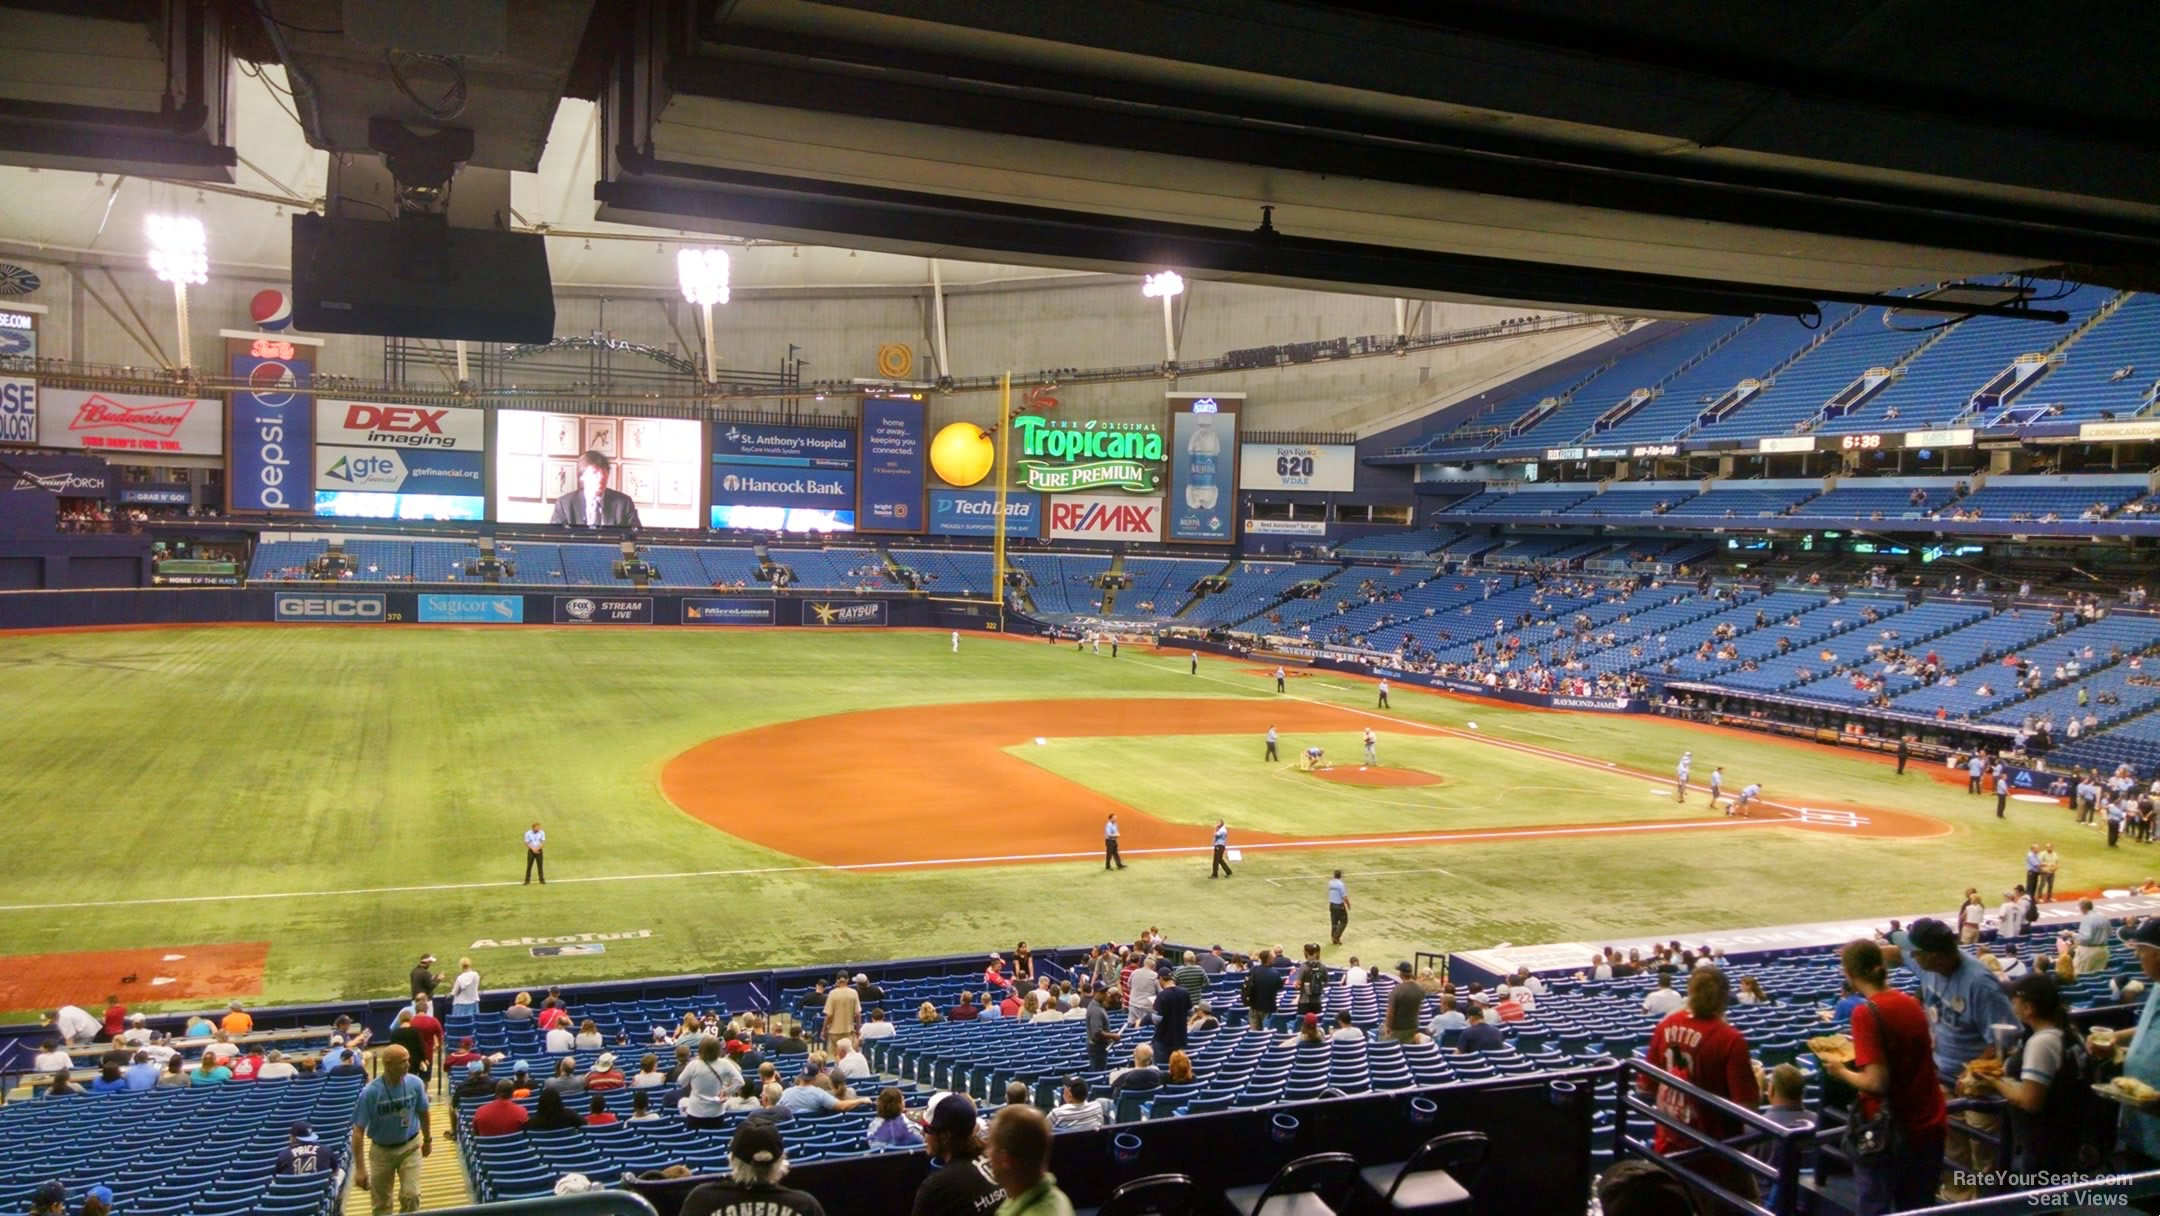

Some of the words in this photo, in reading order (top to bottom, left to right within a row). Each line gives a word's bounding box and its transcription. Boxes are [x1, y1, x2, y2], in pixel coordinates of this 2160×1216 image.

[0, 383, 34, 415] SE
[80, 402, 184, 425] Budweiser
[343, 405, 449, 434] DEX
[882, 418, 905, 427] home
[1051, 420, 1078, 429] THE
[1101, 422, 1157, 431] ORIGINAL
[138, 440, 158, 449] FOR
[367, 431, 457, 448] imaging
[741, 434, 755, 444] St.
[756, 435, 805, 449] Anthony's
[806, 439, 847, 450] Hospital
[870, 436, 901, 446] keeping
[902, 439, 916, 447] you
[1014, 415, 1163, 462] Tropicana
[1842, 434, 1881, 449] 6:38
[872, 447, 914, 456] connected.
[255, 416, 290, 508] pepsi
[353, 455, 393, 478] gte
[1276, 456, 1314, 477] 620
[360, 475, 399, 485] financial
[412, 468, 480, 480] gtefinancial.org
[1029, 469, 1069, 487] PURE
[1071, 465, 1143, 485] PREMIUM
[1281, 477, 1310, 485] WDAE
[67, 478, 105, 489] PORCH
[741, 477, 805, 494] Hancock
[807, 480, 844, 495] Bank
[137, 493, 158, 502] GRAB
[170, 494, 185, 502] GO!
[1052, 502, 1154, 533] RE/MAX
[279, 599, 382, 616] GEICO
[428, 597, 487, 615] Sagicor
[572, 601, 589, 609] FOX
[601, 602, 642, 610] STREAM
[704, 607, 770, 615] MicroLumen
[611, 611, 632, 619] LIVE
[1553, 698, 1594, 708] RAYMOND
[470, 928, 654, 949] AstroTurf
[1664, 1025, 1702, 1048] VOTTO
[291, 1144, 320, 1157] PRICE
[293, 1156, 317, 1175] 14
